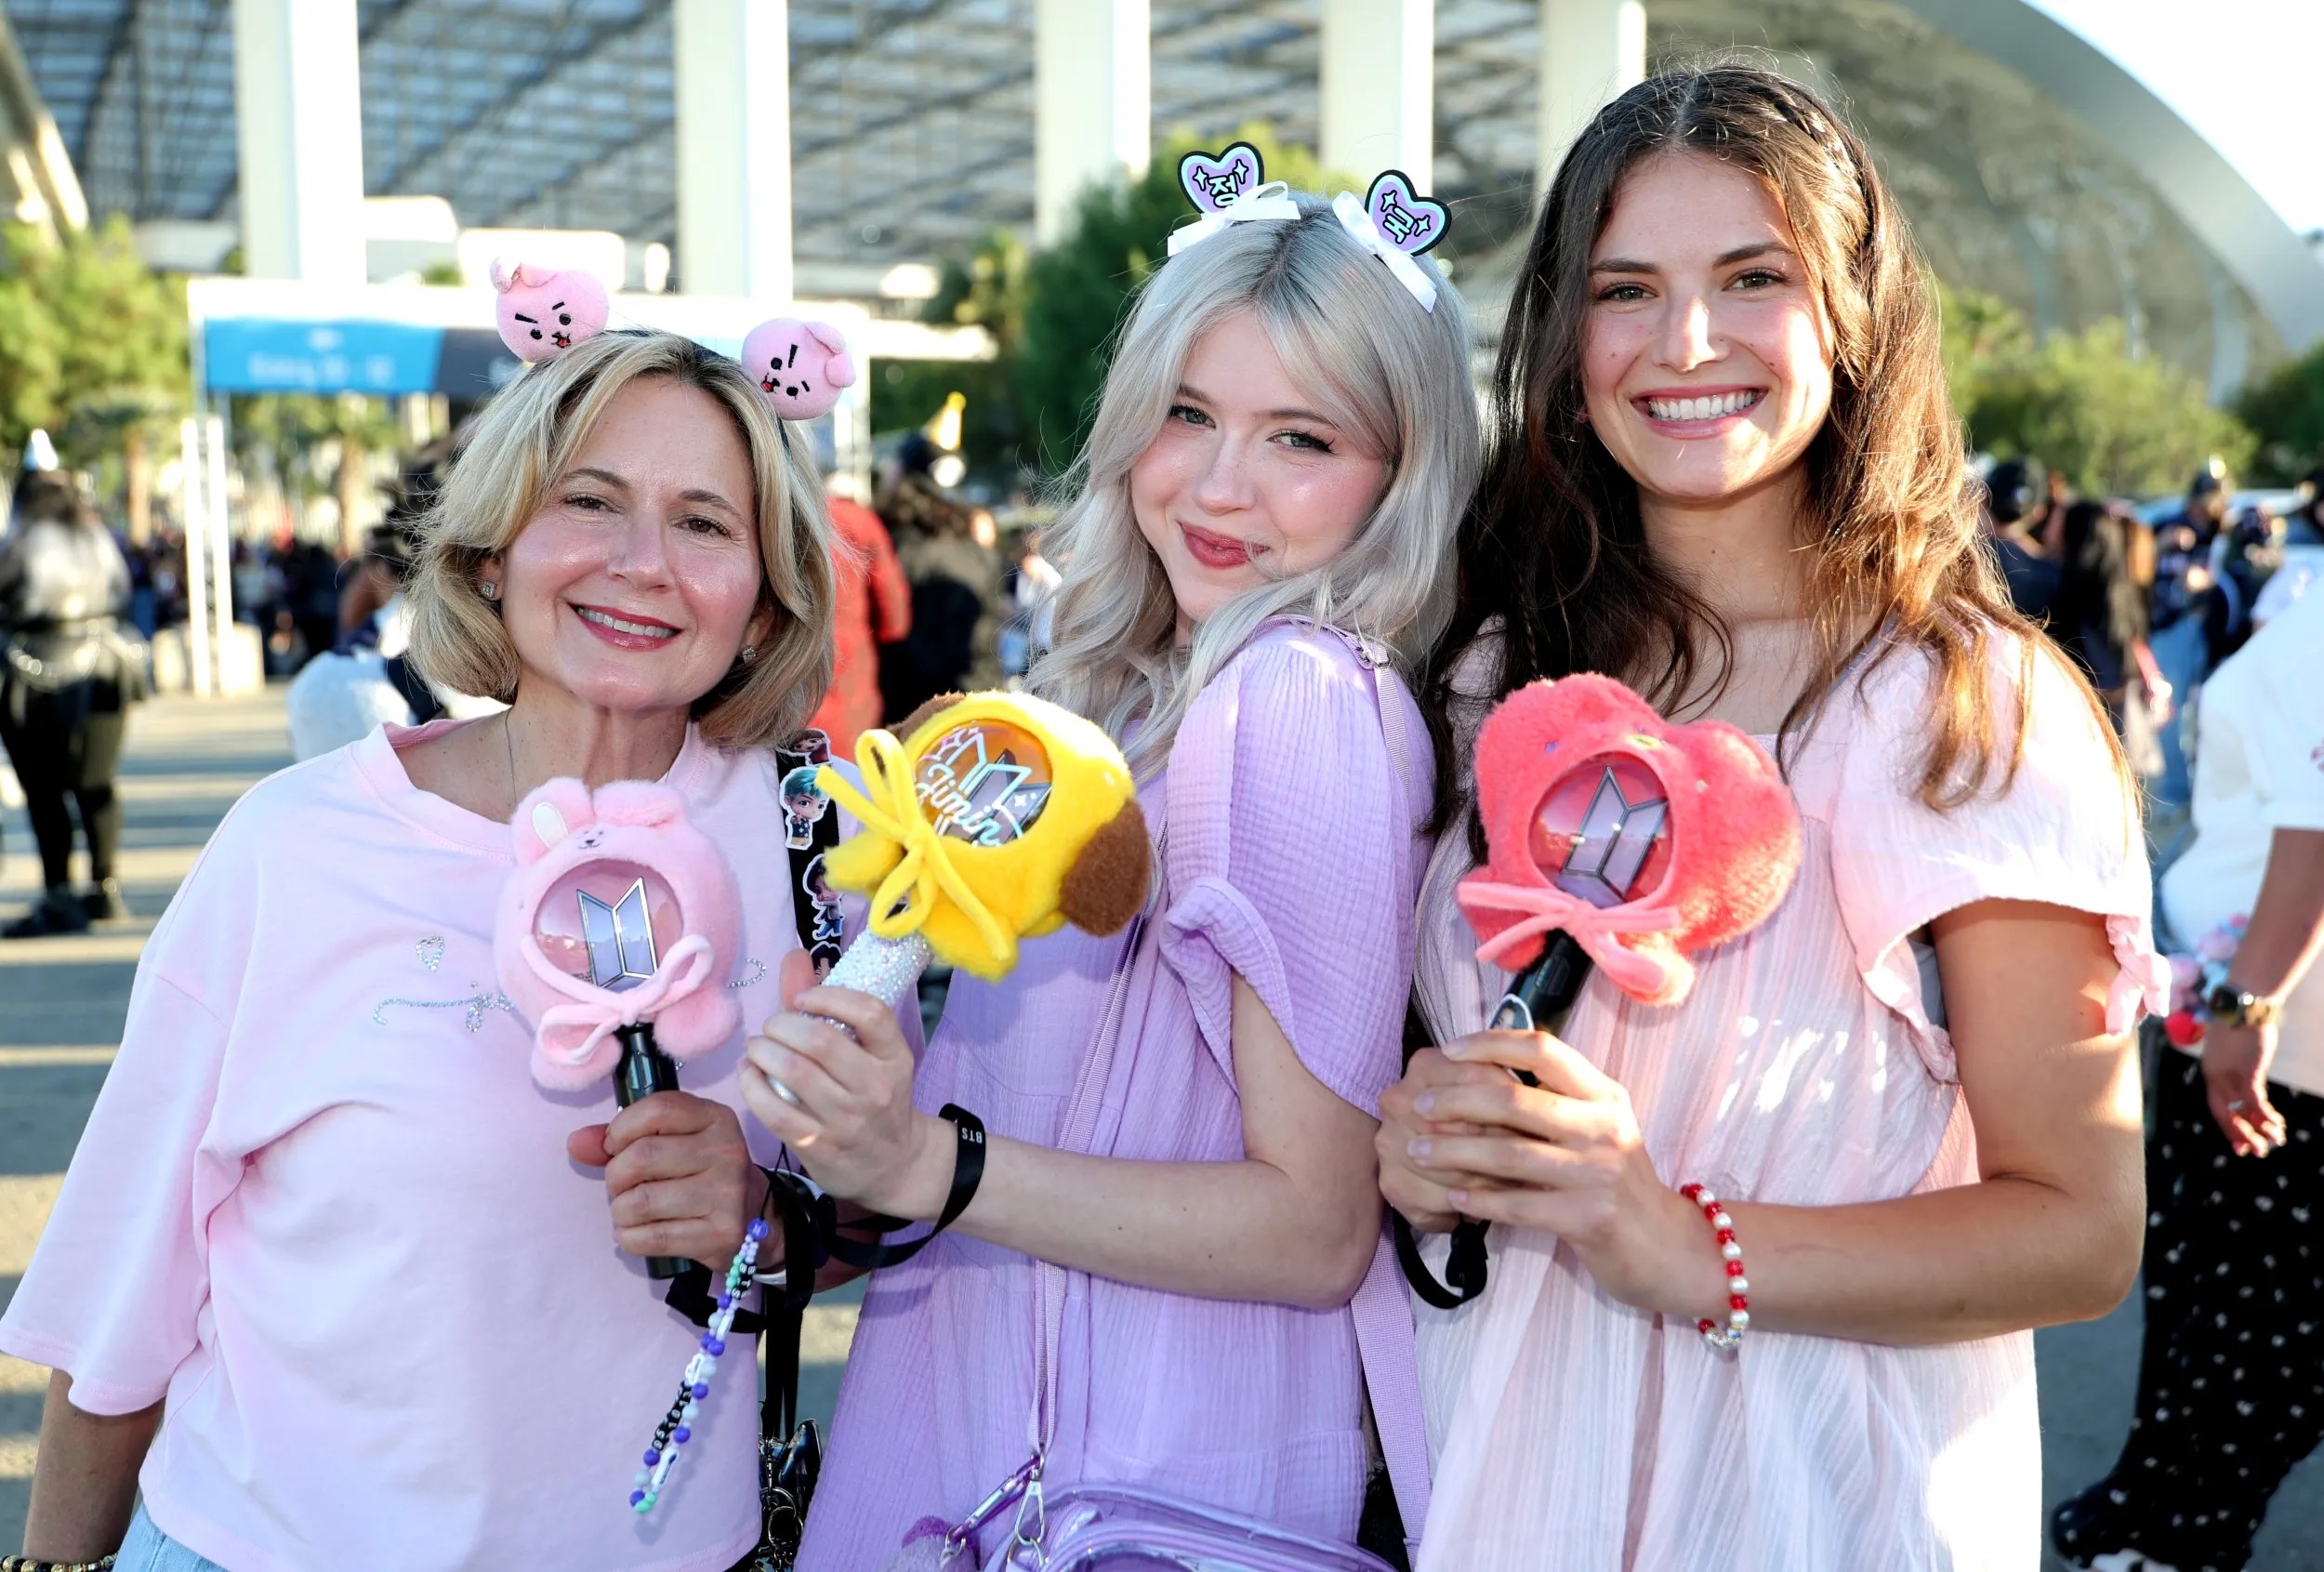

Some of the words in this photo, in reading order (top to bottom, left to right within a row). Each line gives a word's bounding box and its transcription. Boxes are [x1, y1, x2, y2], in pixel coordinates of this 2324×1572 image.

[1208, 174, 1240, 207] 정
[1382, 205, 1416, 244] 국
[916, 762, 1004, 848] Jimin
[961, 1127, 983, 1144] BTS
